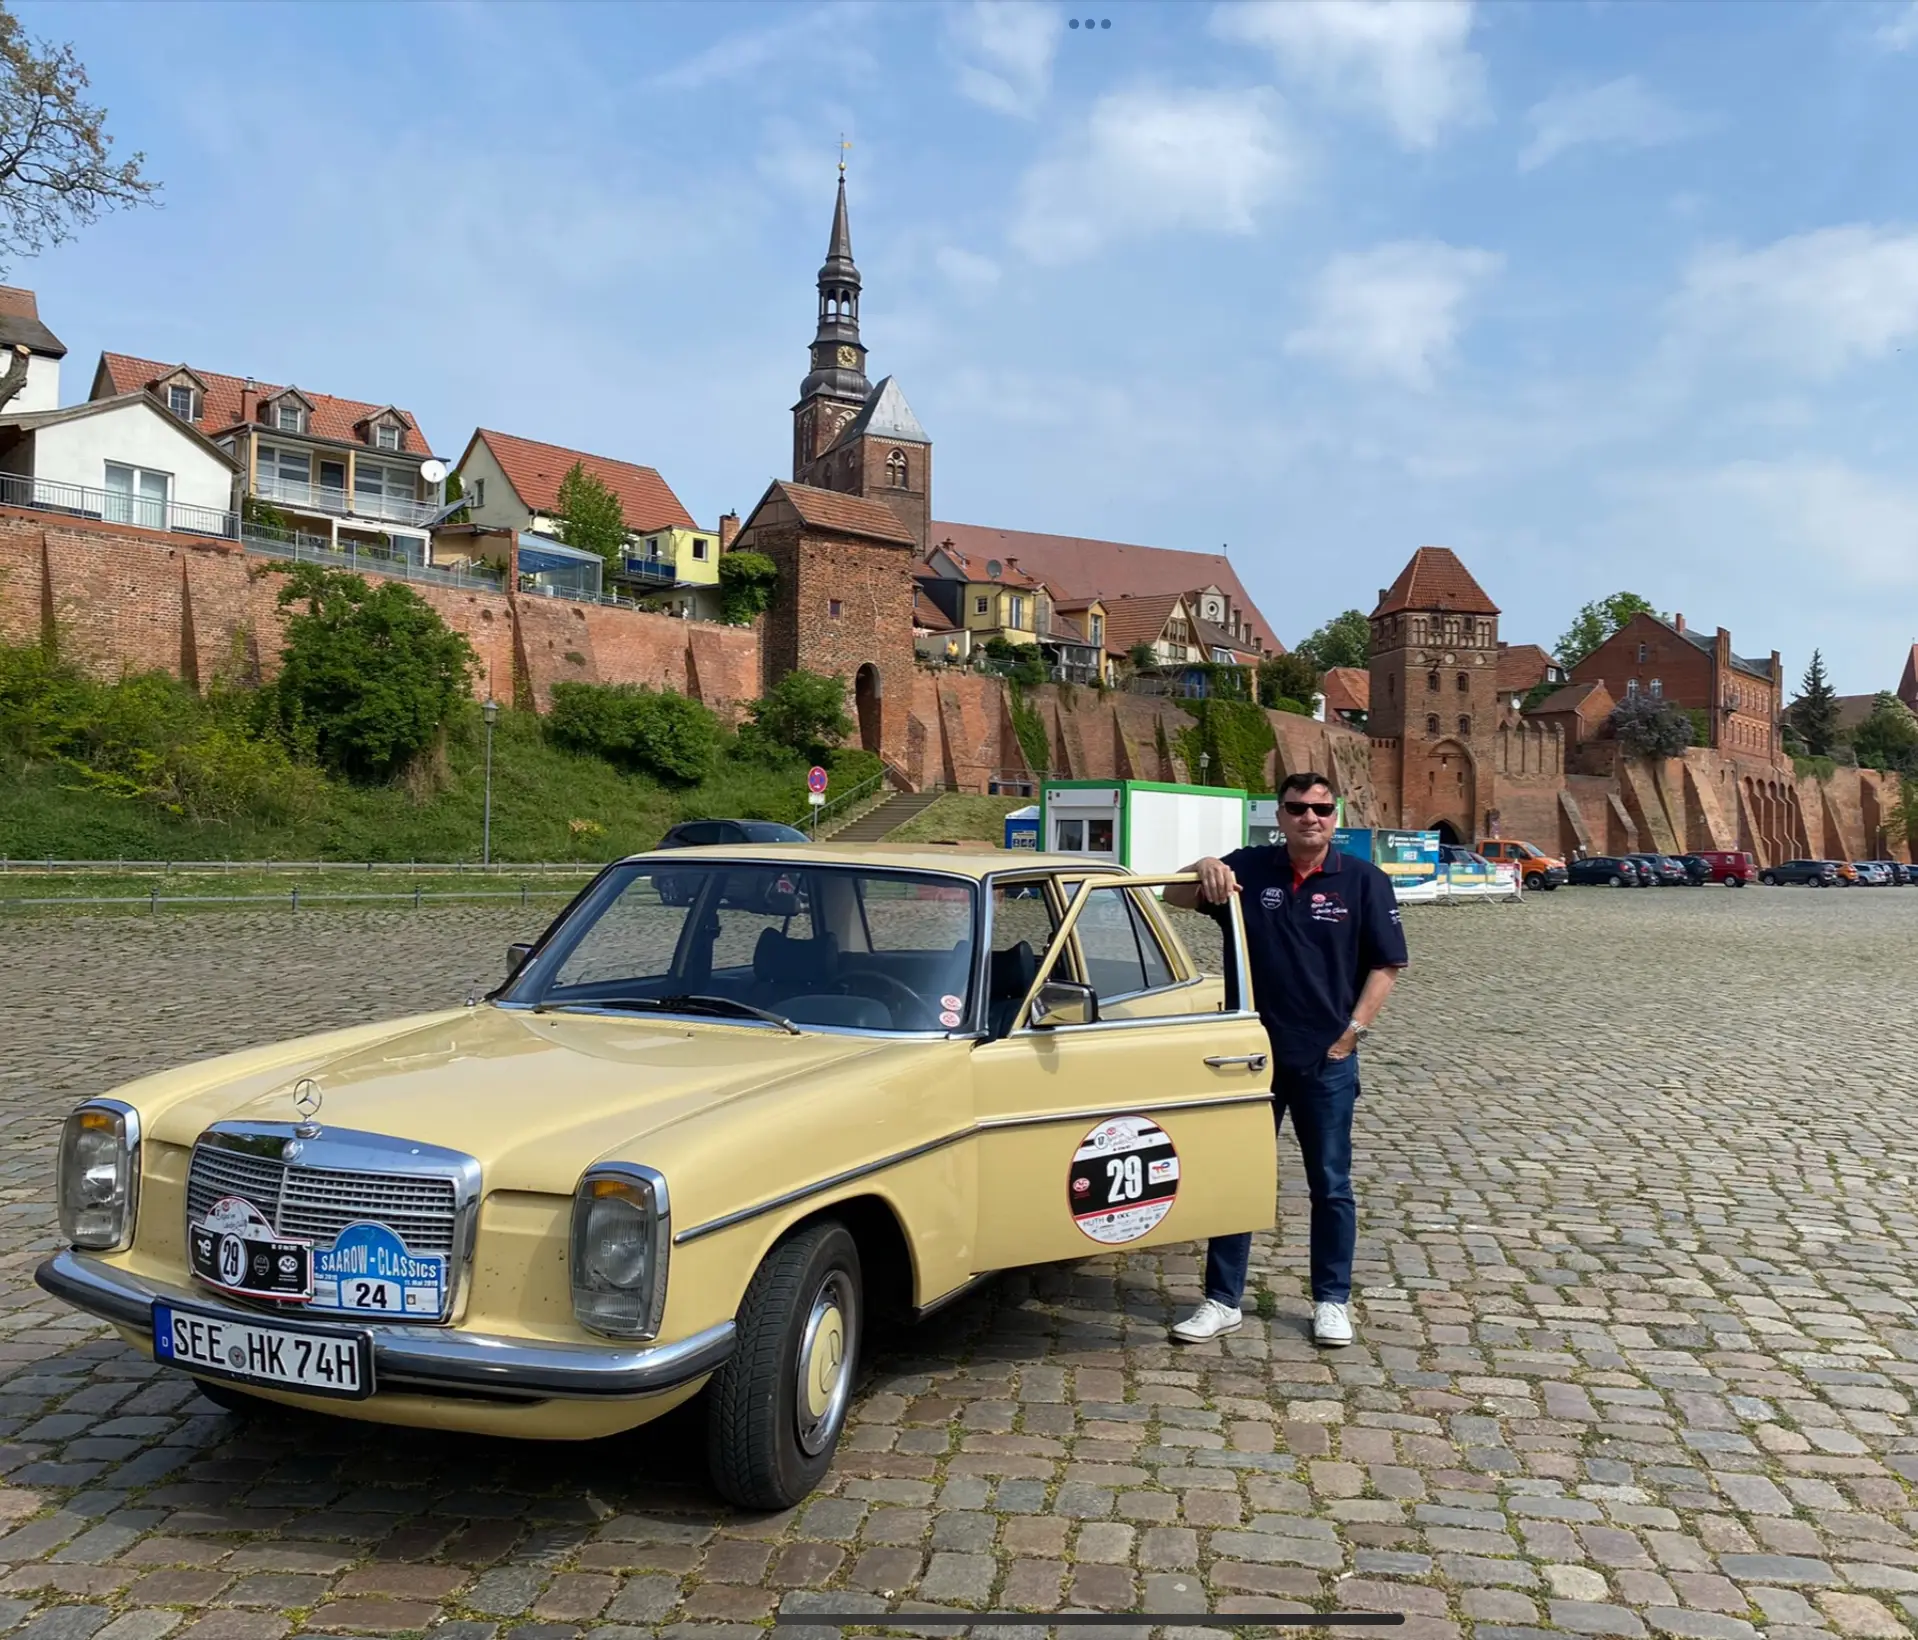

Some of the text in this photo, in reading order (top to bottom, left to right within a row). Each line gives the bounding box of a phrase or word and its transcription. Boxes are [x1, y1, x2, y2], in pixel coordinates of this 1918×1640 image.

[1106, 1155, 1143, 1204] 29
[223, 1240, 239, 1277] 29
[355, 1282, 388, 1309] 24
[161, 1336, 169, 1348] D
[173, 1317, 357, 1386] SEE HK 74H
